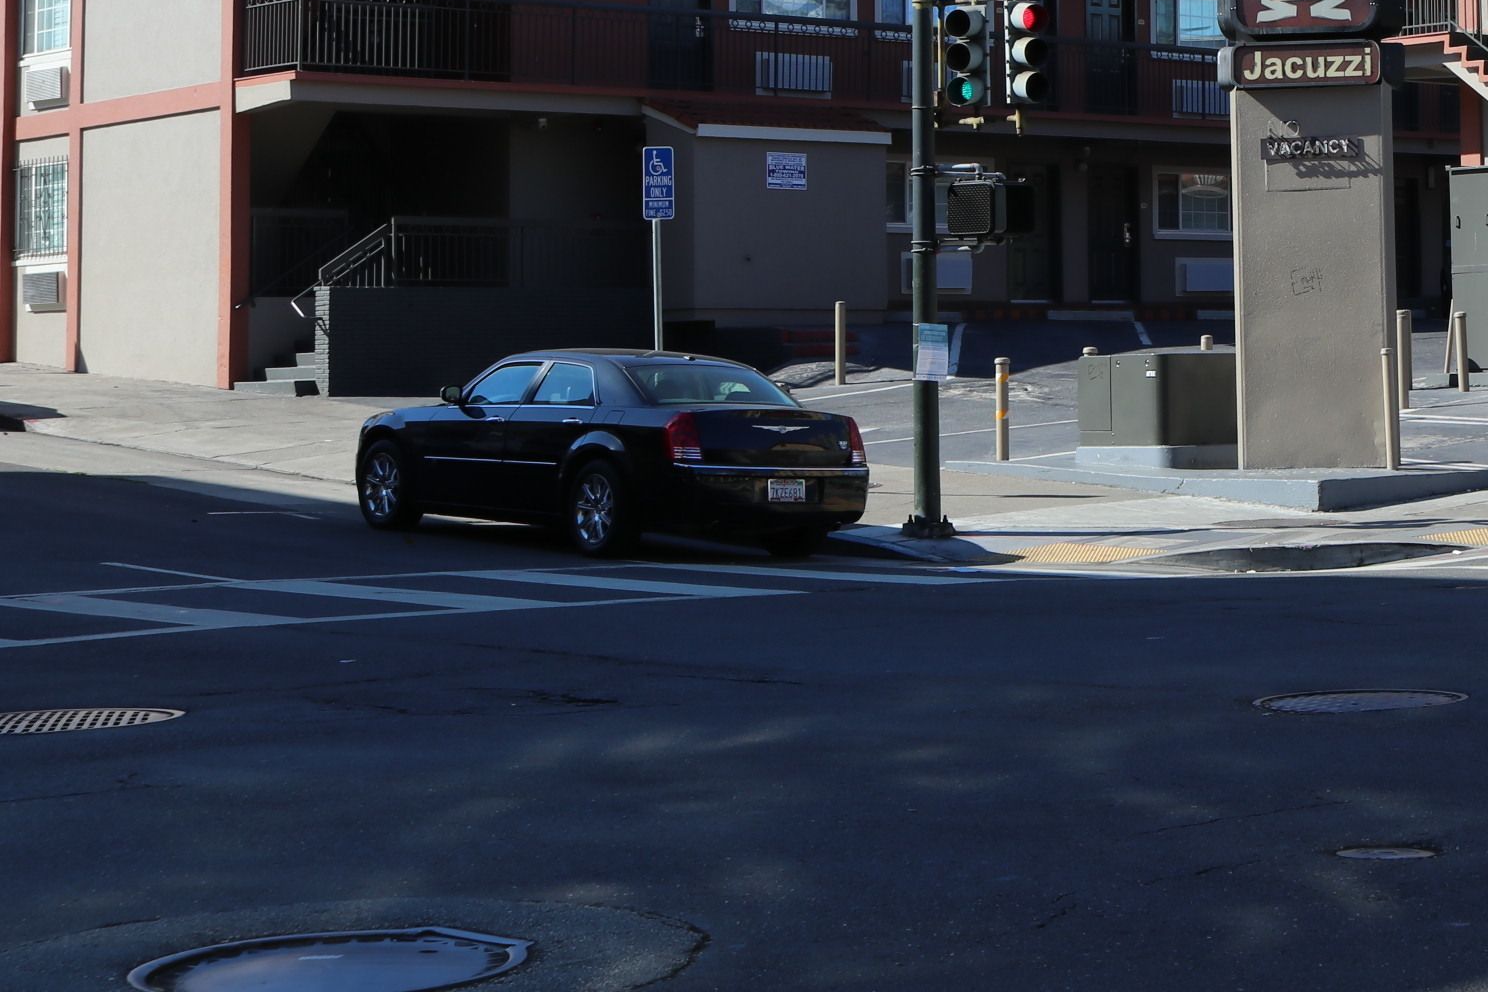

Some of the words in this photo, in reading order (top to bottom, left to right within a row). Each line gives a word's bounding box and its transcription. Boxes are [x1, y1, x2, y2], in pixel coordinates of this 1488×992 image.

[1243, 47, 1371, 81] Jacuzzi
[1266, 138, 1349, 156] VACANCY
[645, 176, 671, 185] PARKING
[650, 187, 667, 197] ONLY
